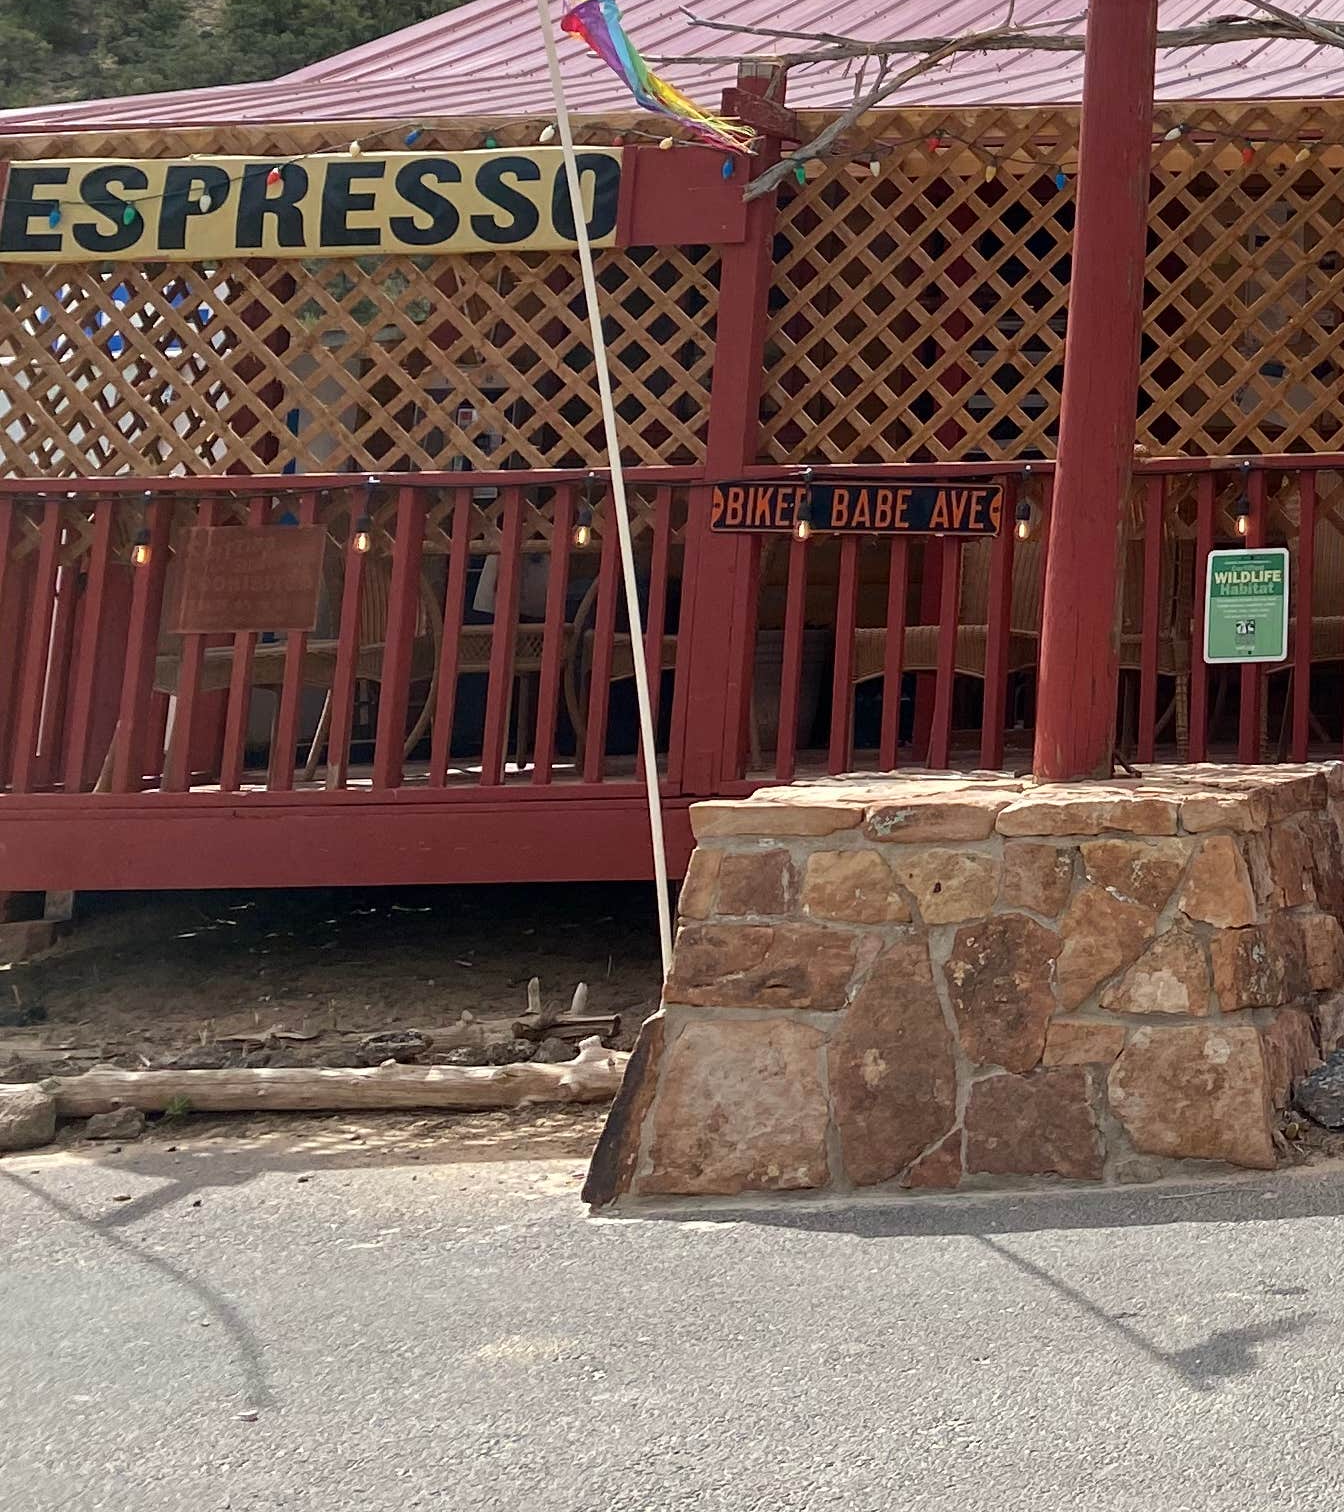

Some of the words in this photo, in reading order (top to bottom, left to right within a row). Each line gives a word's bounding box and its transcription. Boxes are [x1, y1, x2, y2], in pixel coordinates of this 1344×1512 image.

[0, 152, 623, 253] ESPRESSO
[830, 488, 913, 529] BABE
[929, 489, 988, 529] AVE
[1214, 569, 1282, 585] WILDLIFE
[1220, 582, 1275, 596] Habitat
